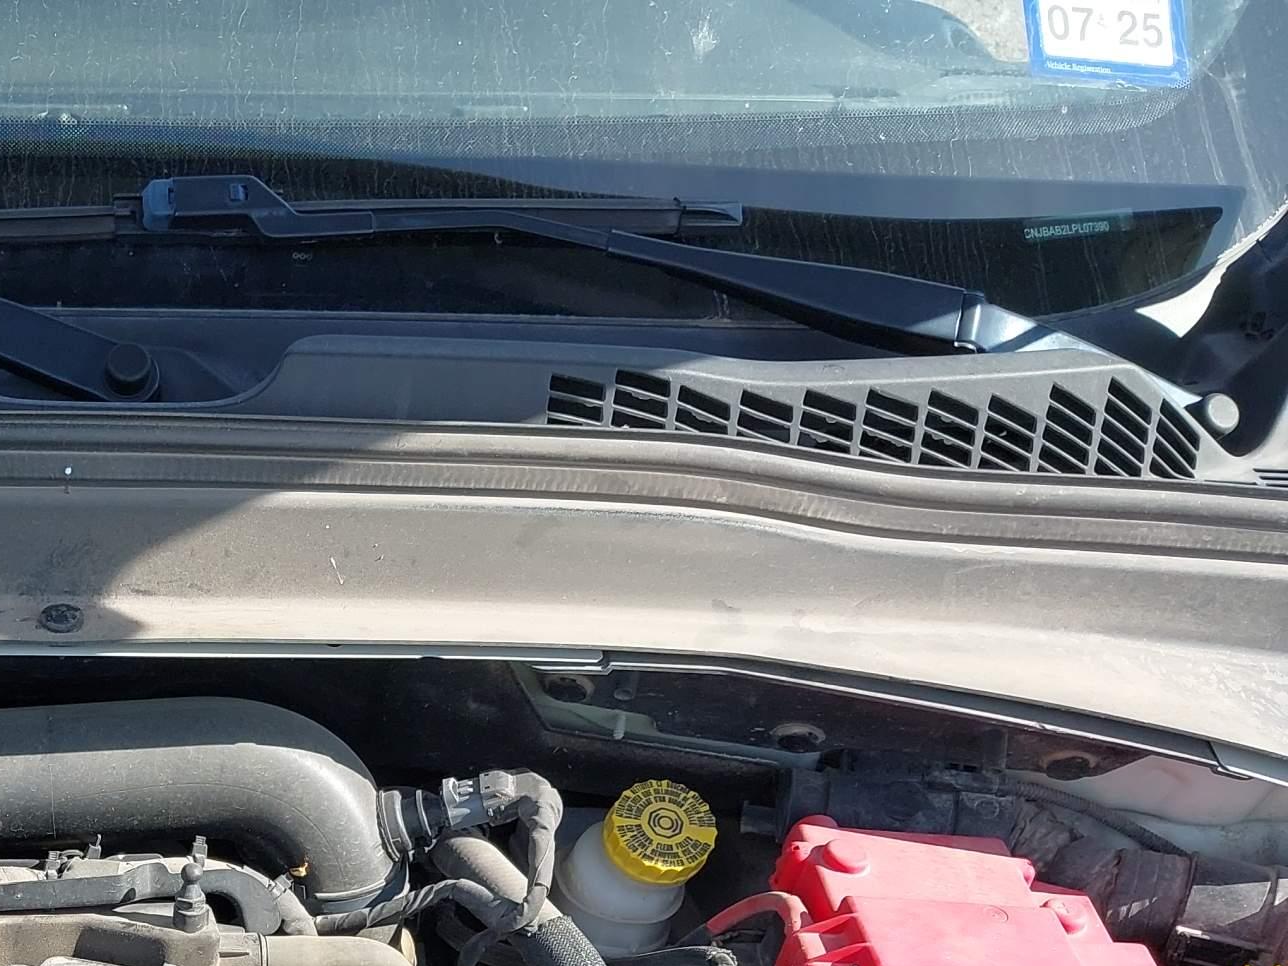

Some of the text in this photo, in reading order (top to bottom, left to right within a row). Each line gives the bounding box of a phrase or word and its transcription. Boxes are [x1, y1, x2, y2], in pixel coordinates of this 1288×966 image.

[1048, 4, 1162, 47] 07 25
[1047, 61, 1112, 74] Vehicle Registration
